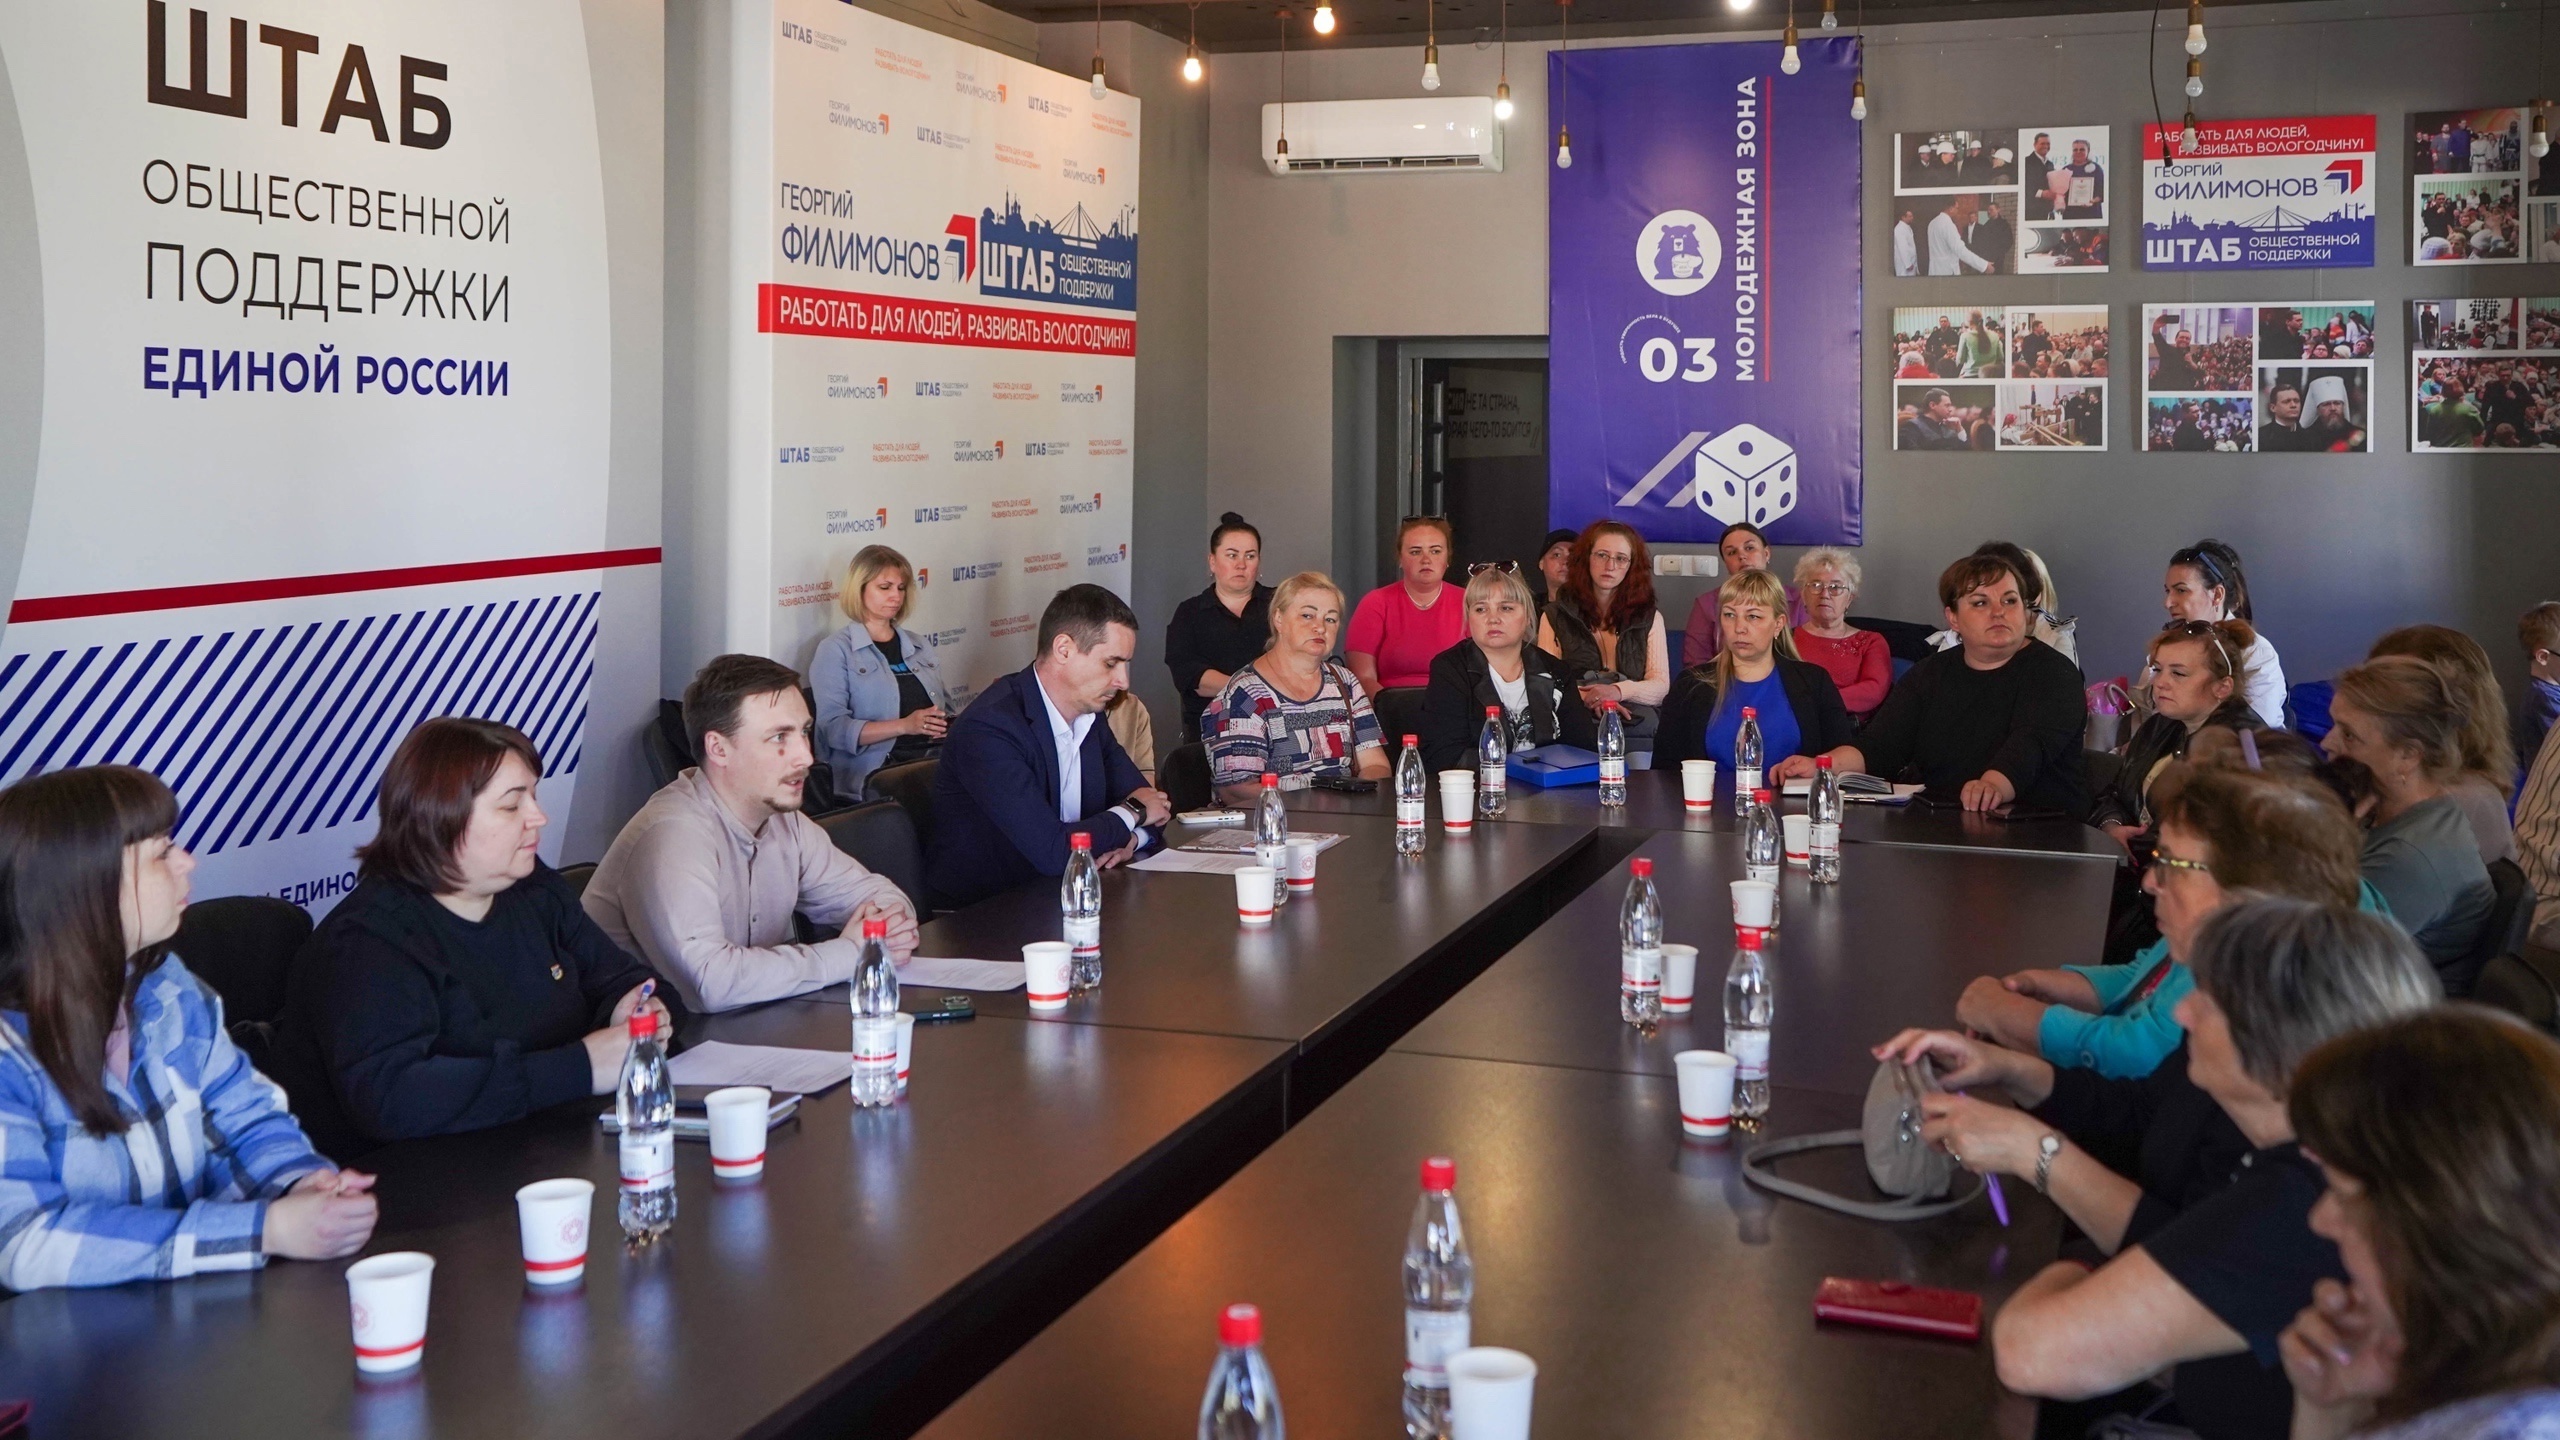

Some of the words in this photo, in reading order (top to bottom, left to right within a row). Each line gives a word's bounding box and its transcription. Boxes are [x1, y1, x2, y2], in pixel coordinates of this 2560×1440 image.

[782, 21, 813, 45] ШТАБ
[146, 0, 452, 150] ШТАБ
[1028, 96, 1049, 113] ШТАБ
[829, 112, 877, 134] ФИЛИМОНОВ
[1736, 77, 1756, 158] ЗОНА
[917, 126, 942, 145] ШТАБ
[2154, 130, 2222, 143] РАБАТЬ
[2225, 128, 2253, 141] ДЛЯ
[2256, 124, 2310, 140] ЛЮДЕЙ,
[2178, 142, 2253, 156] РЗВИВАТЬ
[2257, 138, 2364, 154] ВОЛОГОДЧИНУ!
[2154, 162, 2222, 178] ГЕОРГИЙ
[2154, 178, 2318, 200] ФИЛИМОНОВ
[142, 159, 510, 245] ОБЩЕСТВЕННОЙ
[781, 182, 853, 220] ГЕОРГИЙ
[782, 223, 940, 281] ФИЛИМОНОВ
[2146, 237, 2241, 264] ШТАБ
[2249, 233, 2360, 249] ОБЩЕСТВЕННОЙ
[2249, 249, 2331, 263] ПОДДЕРЖКИ
[983, 241, 1055, 294] ШТАБ
[1060, 252, 1132, 280] ОБЩЕСТВЕННОЙ
[1736, 168, 1758, 381] МОЛОДЕЖНАЯ
[146, 241, 509, 323] ПОДДЕРЖКИ
[1060, 277, 1114, 301] ПОДДЕРЖКИ
[780, 295, 867, 330] РАБОТАТЬ
[871, 305, 904, 333] ДЛЯ
[908, 308, 965, 342] ЛЮДЕЙ,
[968, 314, 1040, 342] РАЗВИВАТЬ
[1043, 320, 1130, 350] ВОЛОГОДЧИНУ!
[143, 344, 340, 398] ЕДИНОЙ
[356, 356, 509, 397] РОССИИ
[1639, 337, 1718, 383] 03
[827, 387, 876, 399] ФИЛИМОНОВ
[916, 381, 940, 397] ШТАБ
[1469, 421, 1500, 438] ЧЕГО-ТО
[1502, 421, 1531, 438] БОИТСЯ
[780, 447, 810, 463] ШТАБ
[953, 450, 994, 462] ФИЛИМОНОВ
[1025, 442, 1046, 456] ШТАБ
[826, 519, 875, 534] ФИЛИМОНОВ
[914, 507, 940, 524] ШТАБ
[952, 565, 977, 582] ШТАБ
[280, 871, 357, 907] ЕДИНО
